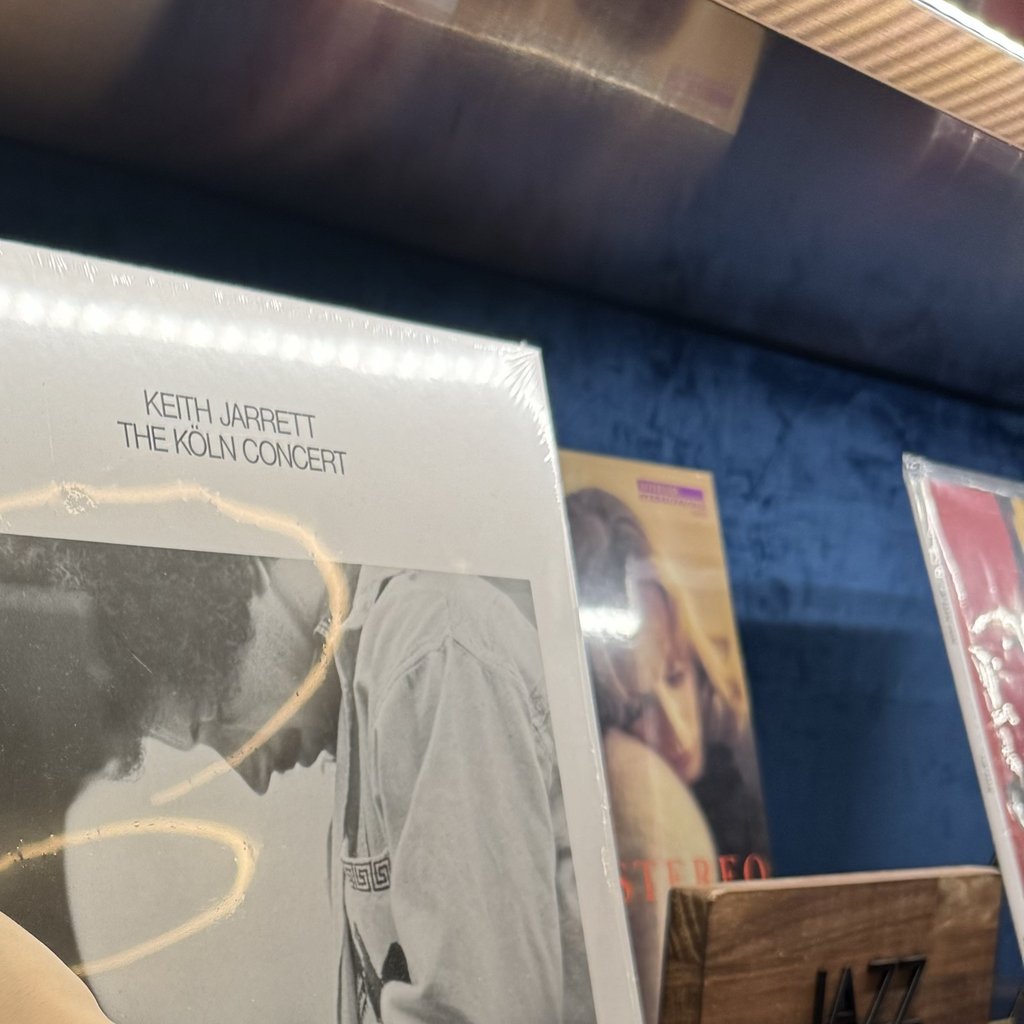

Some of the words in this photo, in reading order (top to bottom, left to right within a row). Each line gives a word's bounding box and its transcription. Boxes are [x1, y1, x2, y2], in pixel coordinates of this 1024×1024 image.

[144, 390, 212, 424] KEITH
[220, 402, 315, 438] JARRETT
[117, 421, 168, 453] THE
[174, 424, 236, 461] KÖLN
[242, 438, 346, 475] CONCERT
